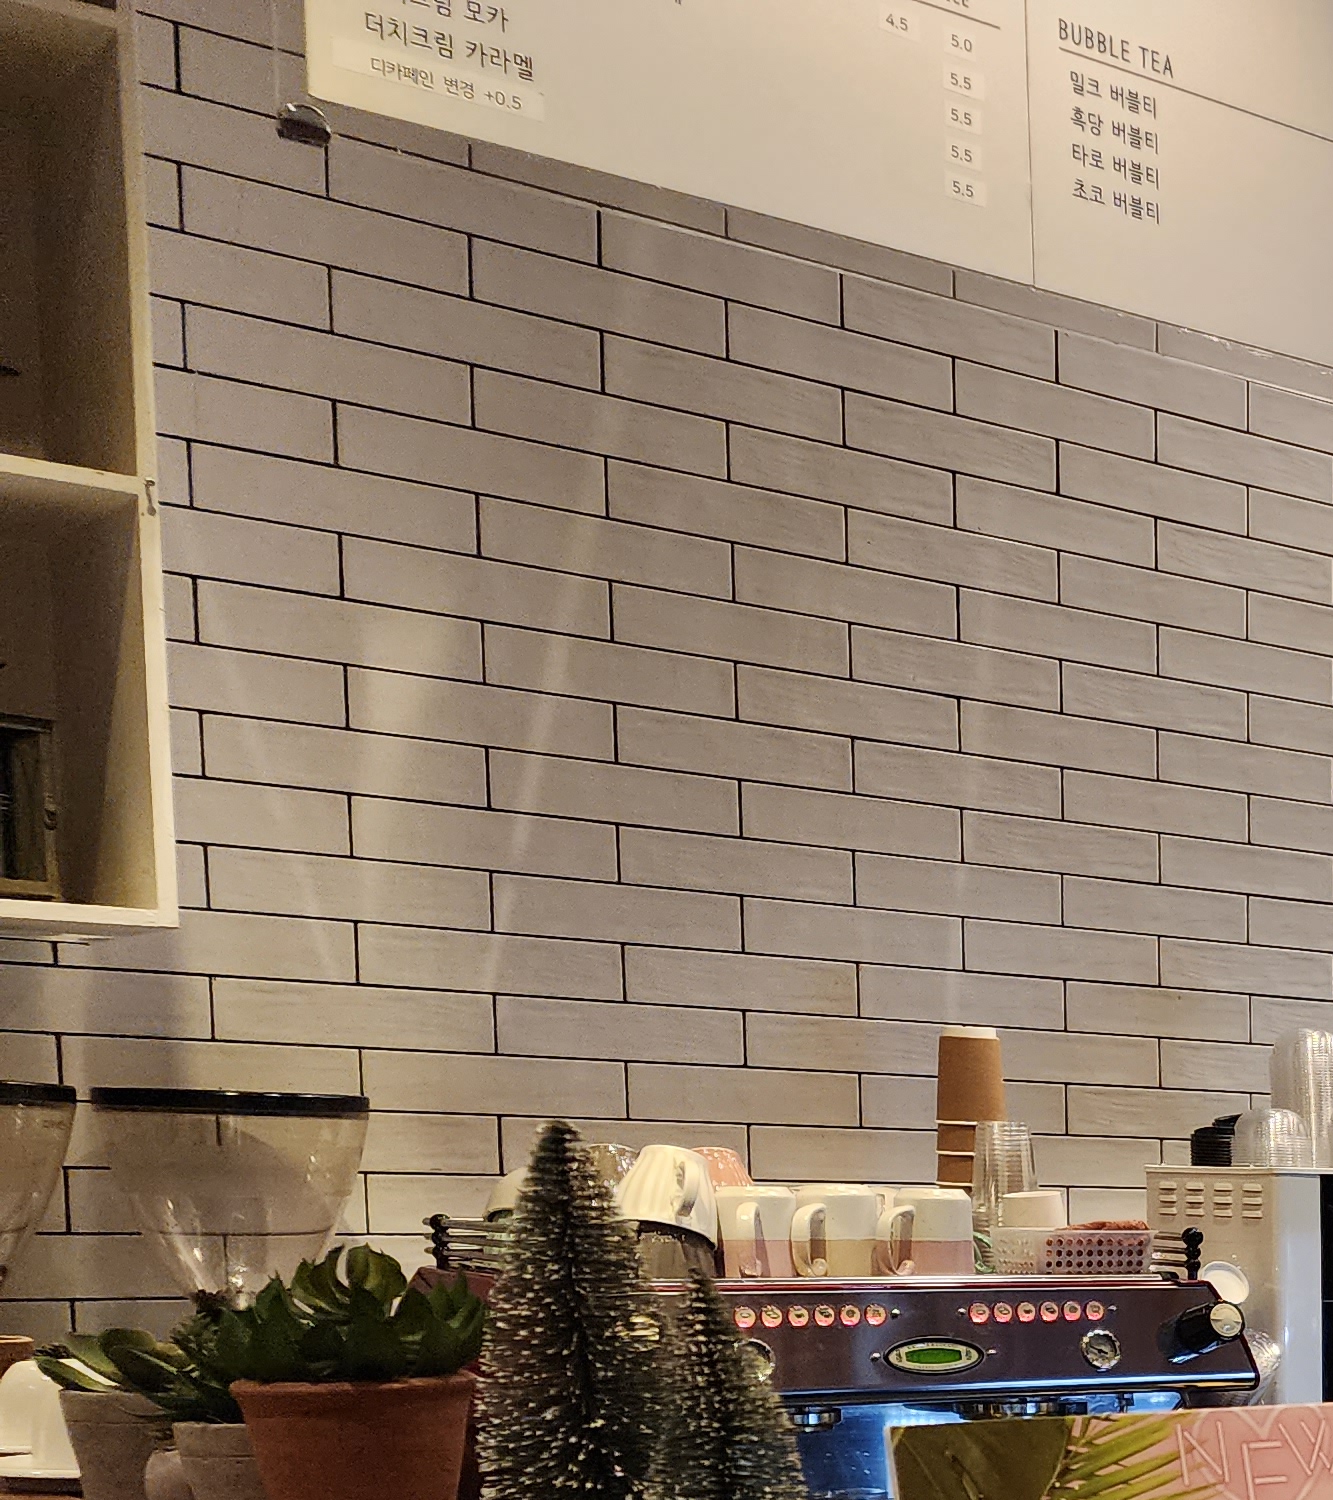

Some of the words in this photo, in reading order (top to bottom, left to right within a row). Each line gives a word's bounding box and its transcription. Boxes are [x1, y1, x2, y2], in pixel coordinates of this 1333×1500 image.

[885, 13, 909, 32] 4.5
[364, 11, 455, 60] 더치크림
[465, 40, 534, 82] 카라멜
[950, 33, 973, 53] 5.0
[1058, 17, 1130, 64] BUBBLE
[1138, 46, 1174, 79] TEA
[443, 76, 475, 100] 변경
[484, 91, 523, 111] +0.5
[950, 72, 972, 91] 5.5
[1070, 71, 1102, 98] 밀크
[1110, 83, 1157, 119] 버블티
[950, 107, 972, 127] 5.5
[1070, 106, 1104, 137] 흑당
[1111, 120, 1159, 155] 버블티
[950, 144, 973, 164] 5.5
[1072, 143, 1104, 171] 타로
[1112, 156, 1160, 190] 버블티
[952, 180, 974, 199] 5.5
[1072, 178, 1105, 205] 초코
[1113, 190, 1160, 225] 버블티
